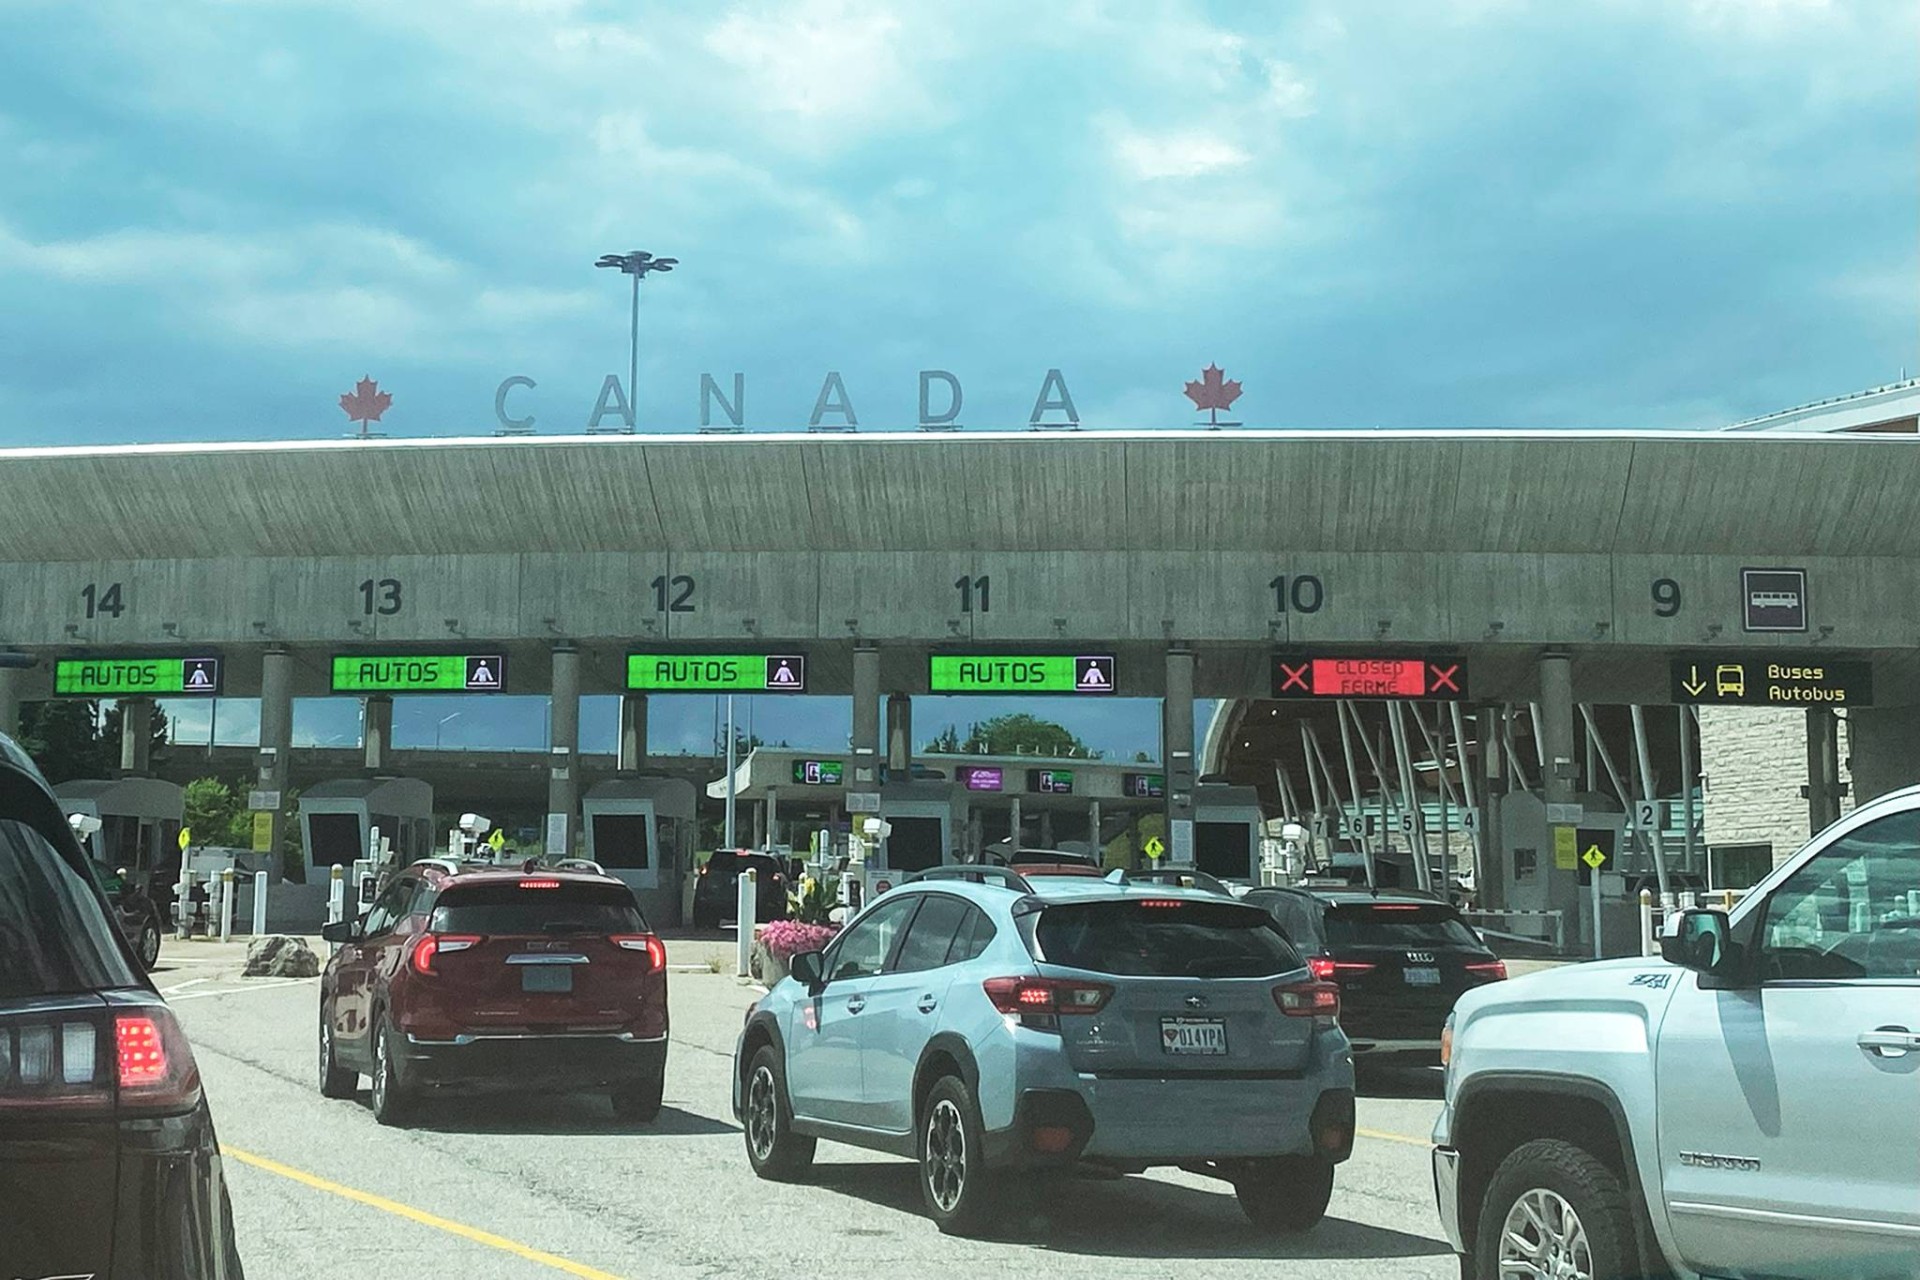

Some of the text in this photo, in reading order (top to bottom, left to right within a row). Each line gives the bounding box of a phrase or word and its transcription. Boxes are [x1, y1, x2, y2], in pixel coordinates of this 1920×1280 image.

[495, 367, 1081, 428] CANADA
[82, 583, 126, 618] 14
[359, 579, 402, 615] 13
[651, 575, 696, 613] 12
[954, 575, 990, 612] 11
[1268, 574, 1324, 613] 10
[1652, 578, 1682, 617] 9
[80, 664, 158, 687] AUTOS
[358, 661, 440, 683] AUTOS
[655, 660, 738, 682] AUTOS
[959, 661, 1046, 684] AUTOS
[1336, 661, 1404, 677] CLOSED
[1768, 664, 1825, 680] Buses
[1769, 685, 1846, 701] Autobus
[1353, 817, 1362, 832] 6
[1402, 815, 1412, 831] 5
[1464, 812, 1474, 829] 4
[1641, 805, 1654, 826] 2
[1314, 821, 1322, 835] 7
